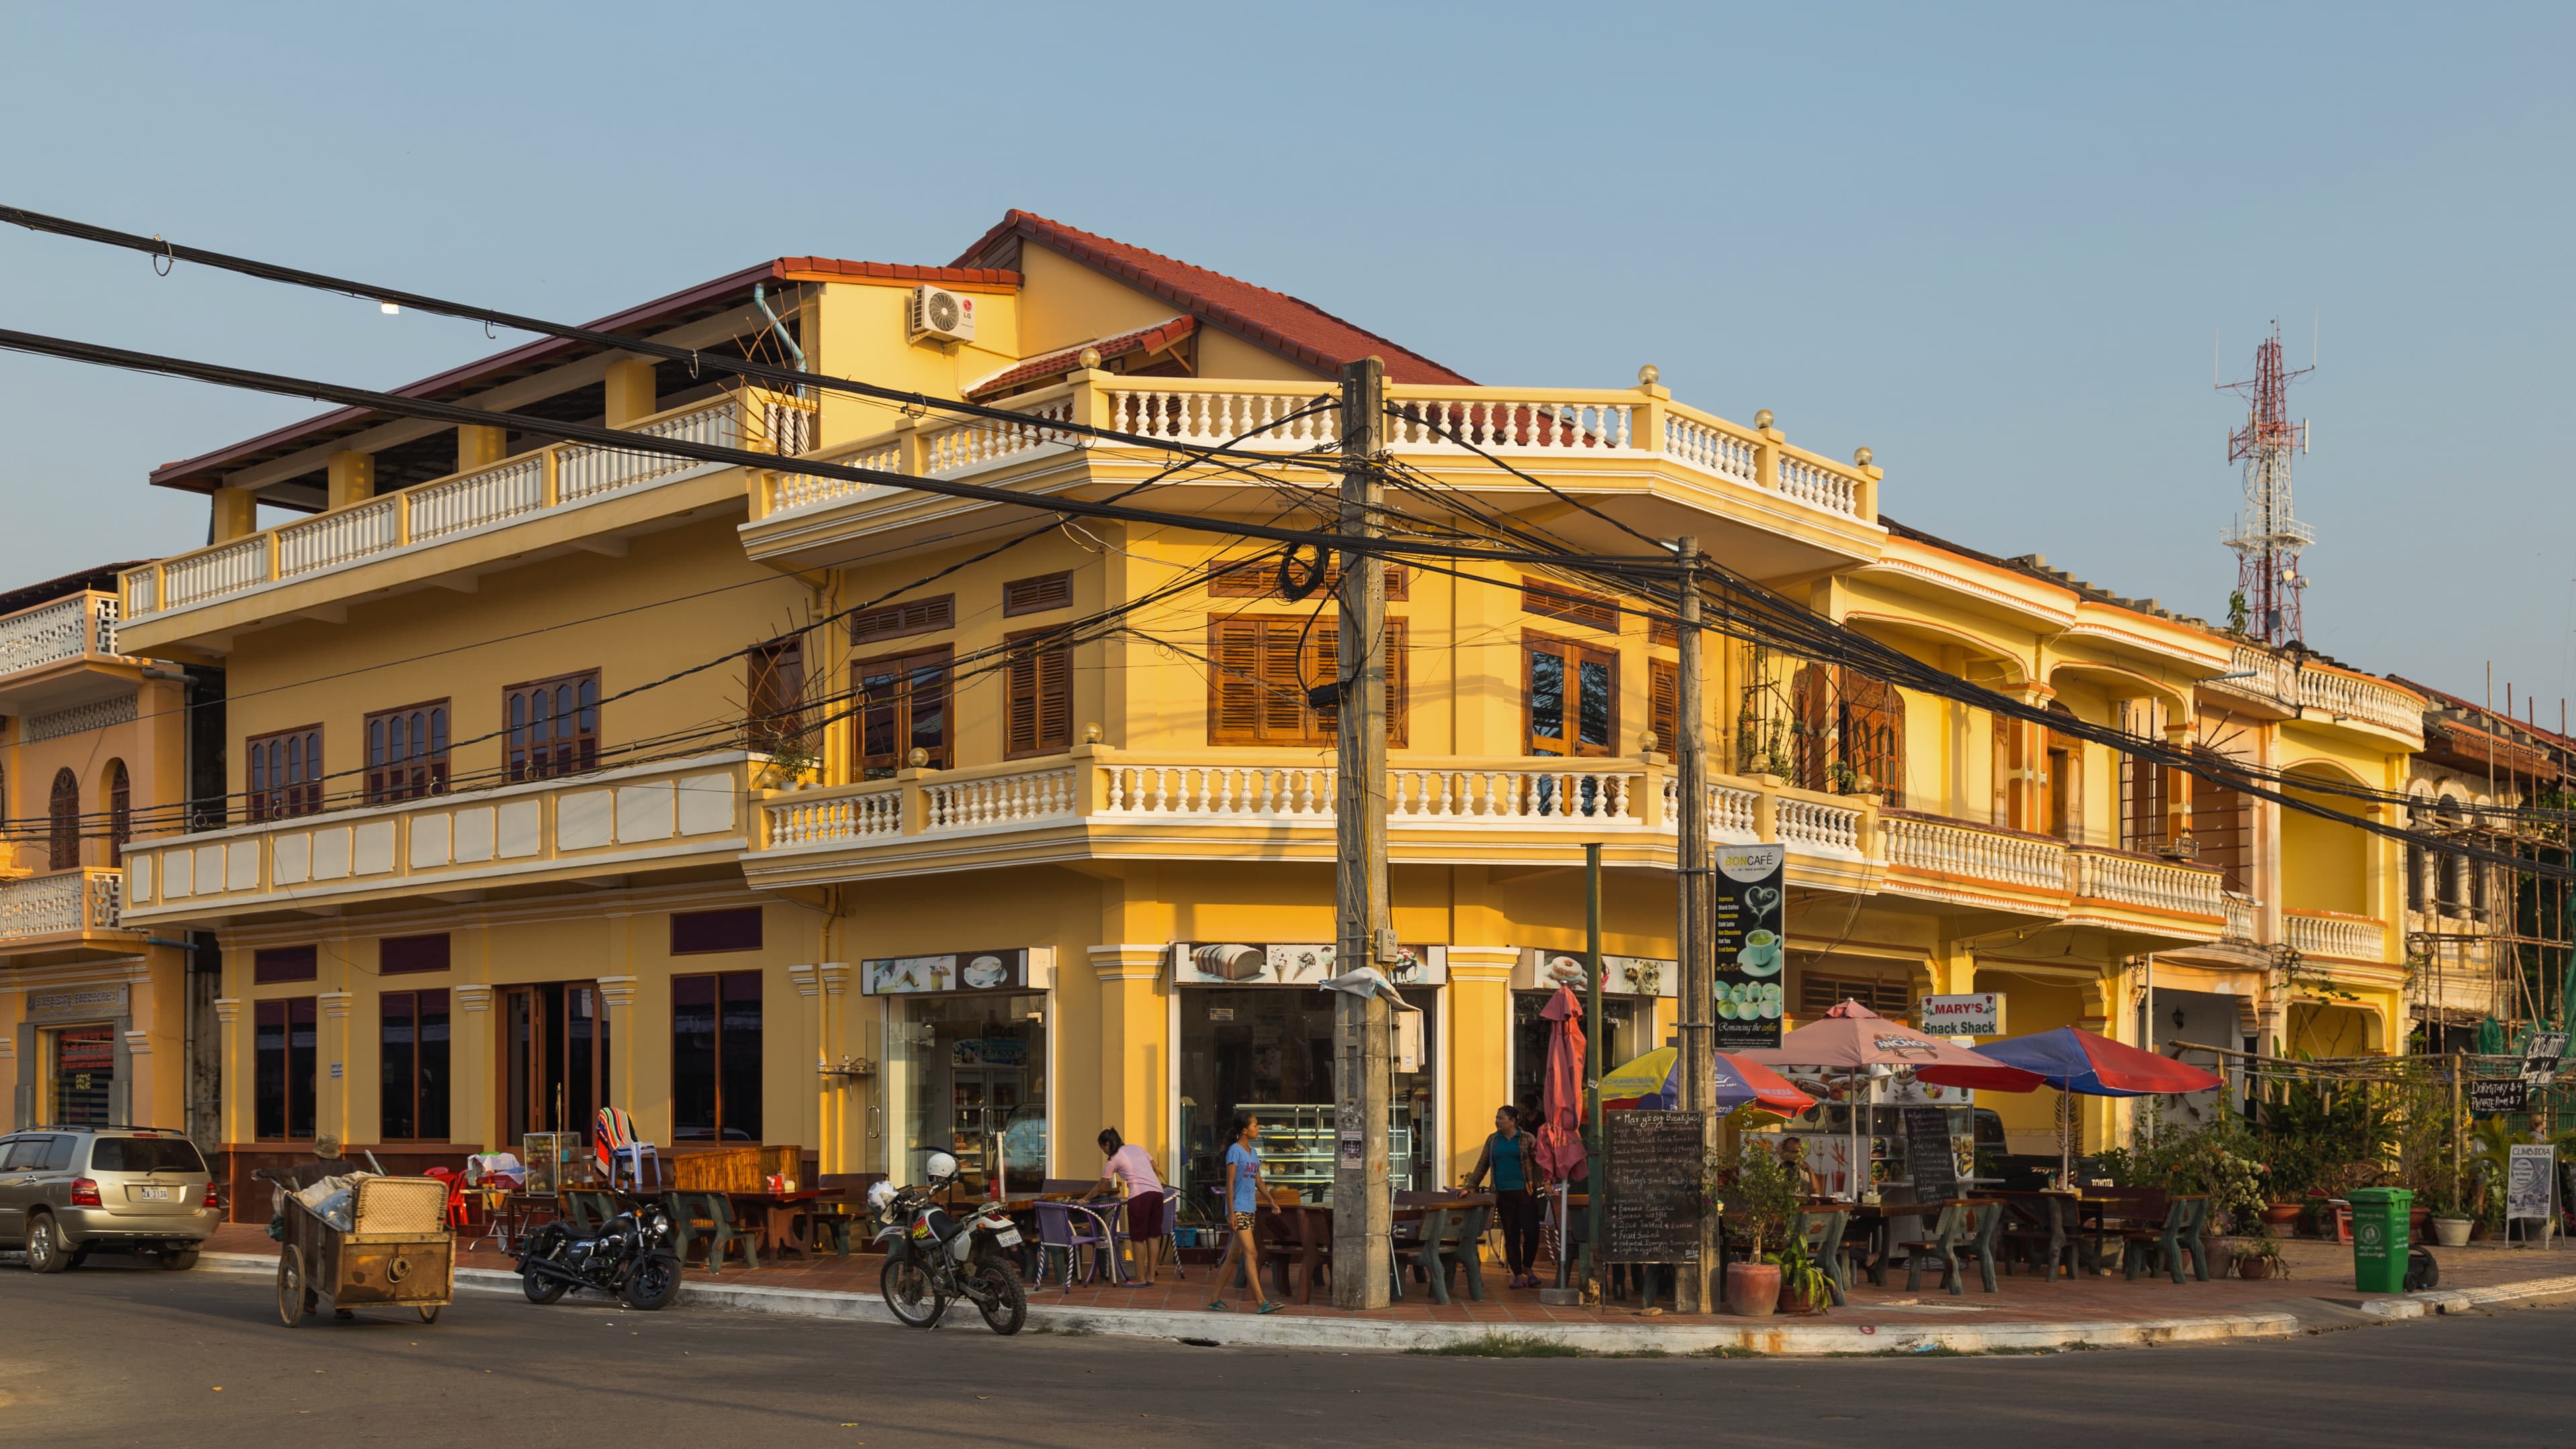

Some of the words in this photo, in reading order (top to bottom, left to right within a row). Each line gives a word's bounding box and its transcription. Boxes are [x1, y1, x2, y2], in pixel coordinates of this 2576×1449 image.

[1725, 853, 1773, 866] BONCAFÉ
[1935, 1004, 1983, 1014] MARY'S
[1924, 1022, 1957, 1034] Snack
[1961, 1021, 1996, 1034] Shack
[2470, 1081, 2509, 1095] DORMITORY
[2092, 1179, 2113, 1187] TOYOTA
